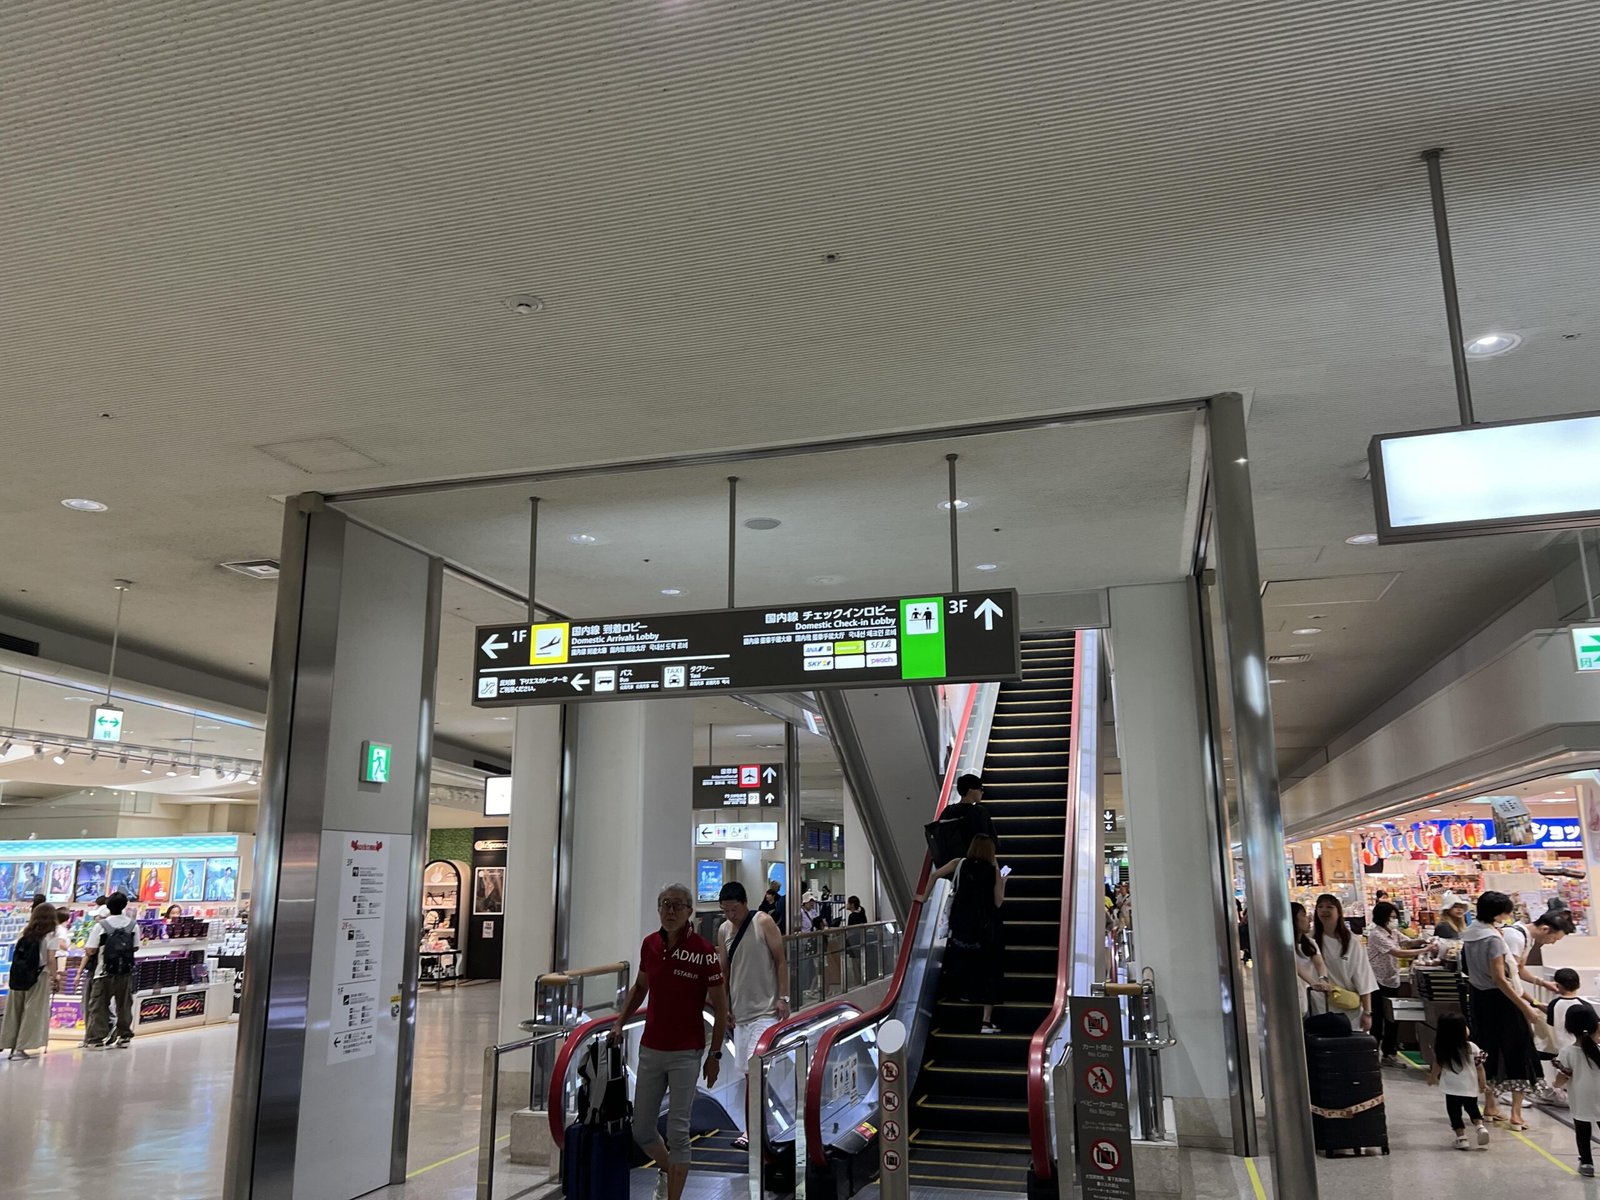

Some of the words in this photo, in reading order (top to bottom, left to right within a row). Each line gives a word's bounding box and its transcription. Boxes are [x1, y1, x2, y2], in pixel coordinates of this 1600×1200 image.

[949, 599, 968, 614] 3F
[765, 611, 799, 624] 国内線
[802, 605, 896, 621] チェックインロビー
[571, 625, 600, 637] 国内線
[602, 622, 648, 635] 到着ロビー
[795, 620, 832, 631] Domestic
[833, 618, 869, 629] Check-in
[870, 617, 896, 627] Lobby
[511, 630, 527, 643] 1F
[571, 636, 605, 646] Domestic
[606, 633, 635, 643] Arrivals
[636, 632, 659, 642] Lobby
[871, 656, 893, 665] peach
[620, 669, 633, 677] バス
[690, 665, 715, 673] タクシー
[1082, 1043, 1114, 1052] カート禁止
